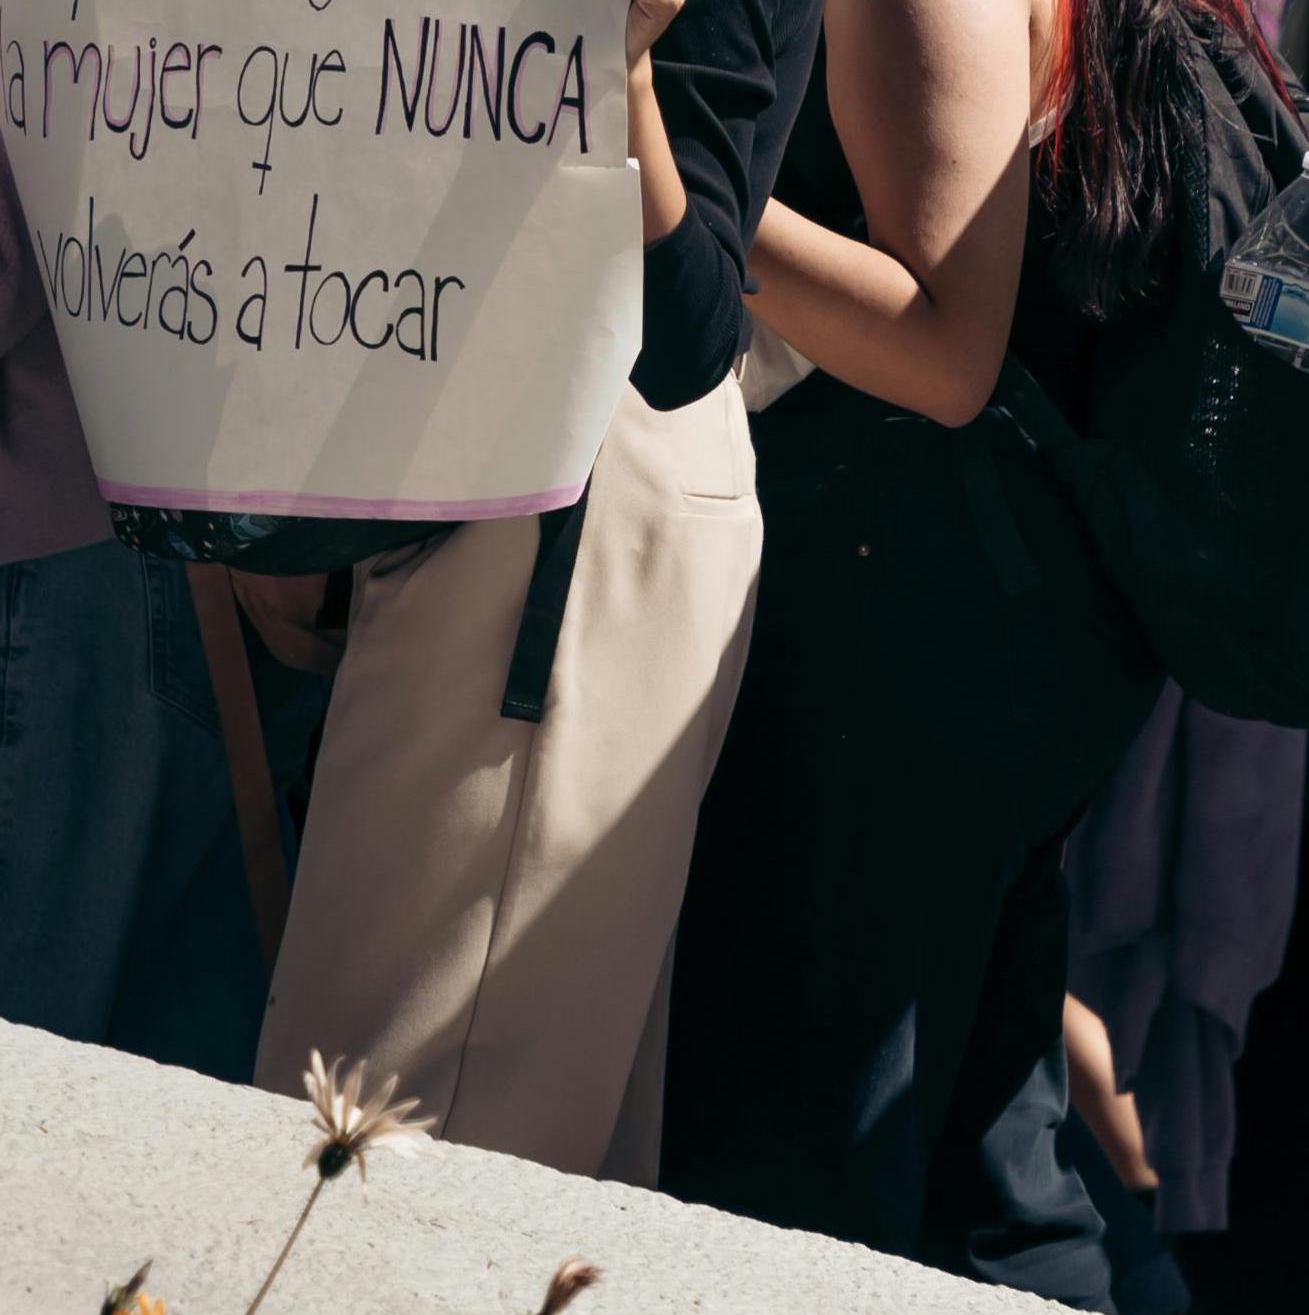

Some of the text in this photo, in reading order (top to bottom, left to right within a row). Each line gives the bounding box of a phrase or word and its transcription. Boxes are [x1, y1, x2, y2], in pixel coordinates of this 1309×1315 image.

[43, 36, 223, 160] mujer
[237, 44, 346, 196] que
[374, 16, 590, 154] NUNCA
[37, 194, 465, 362] volverás a tocar
